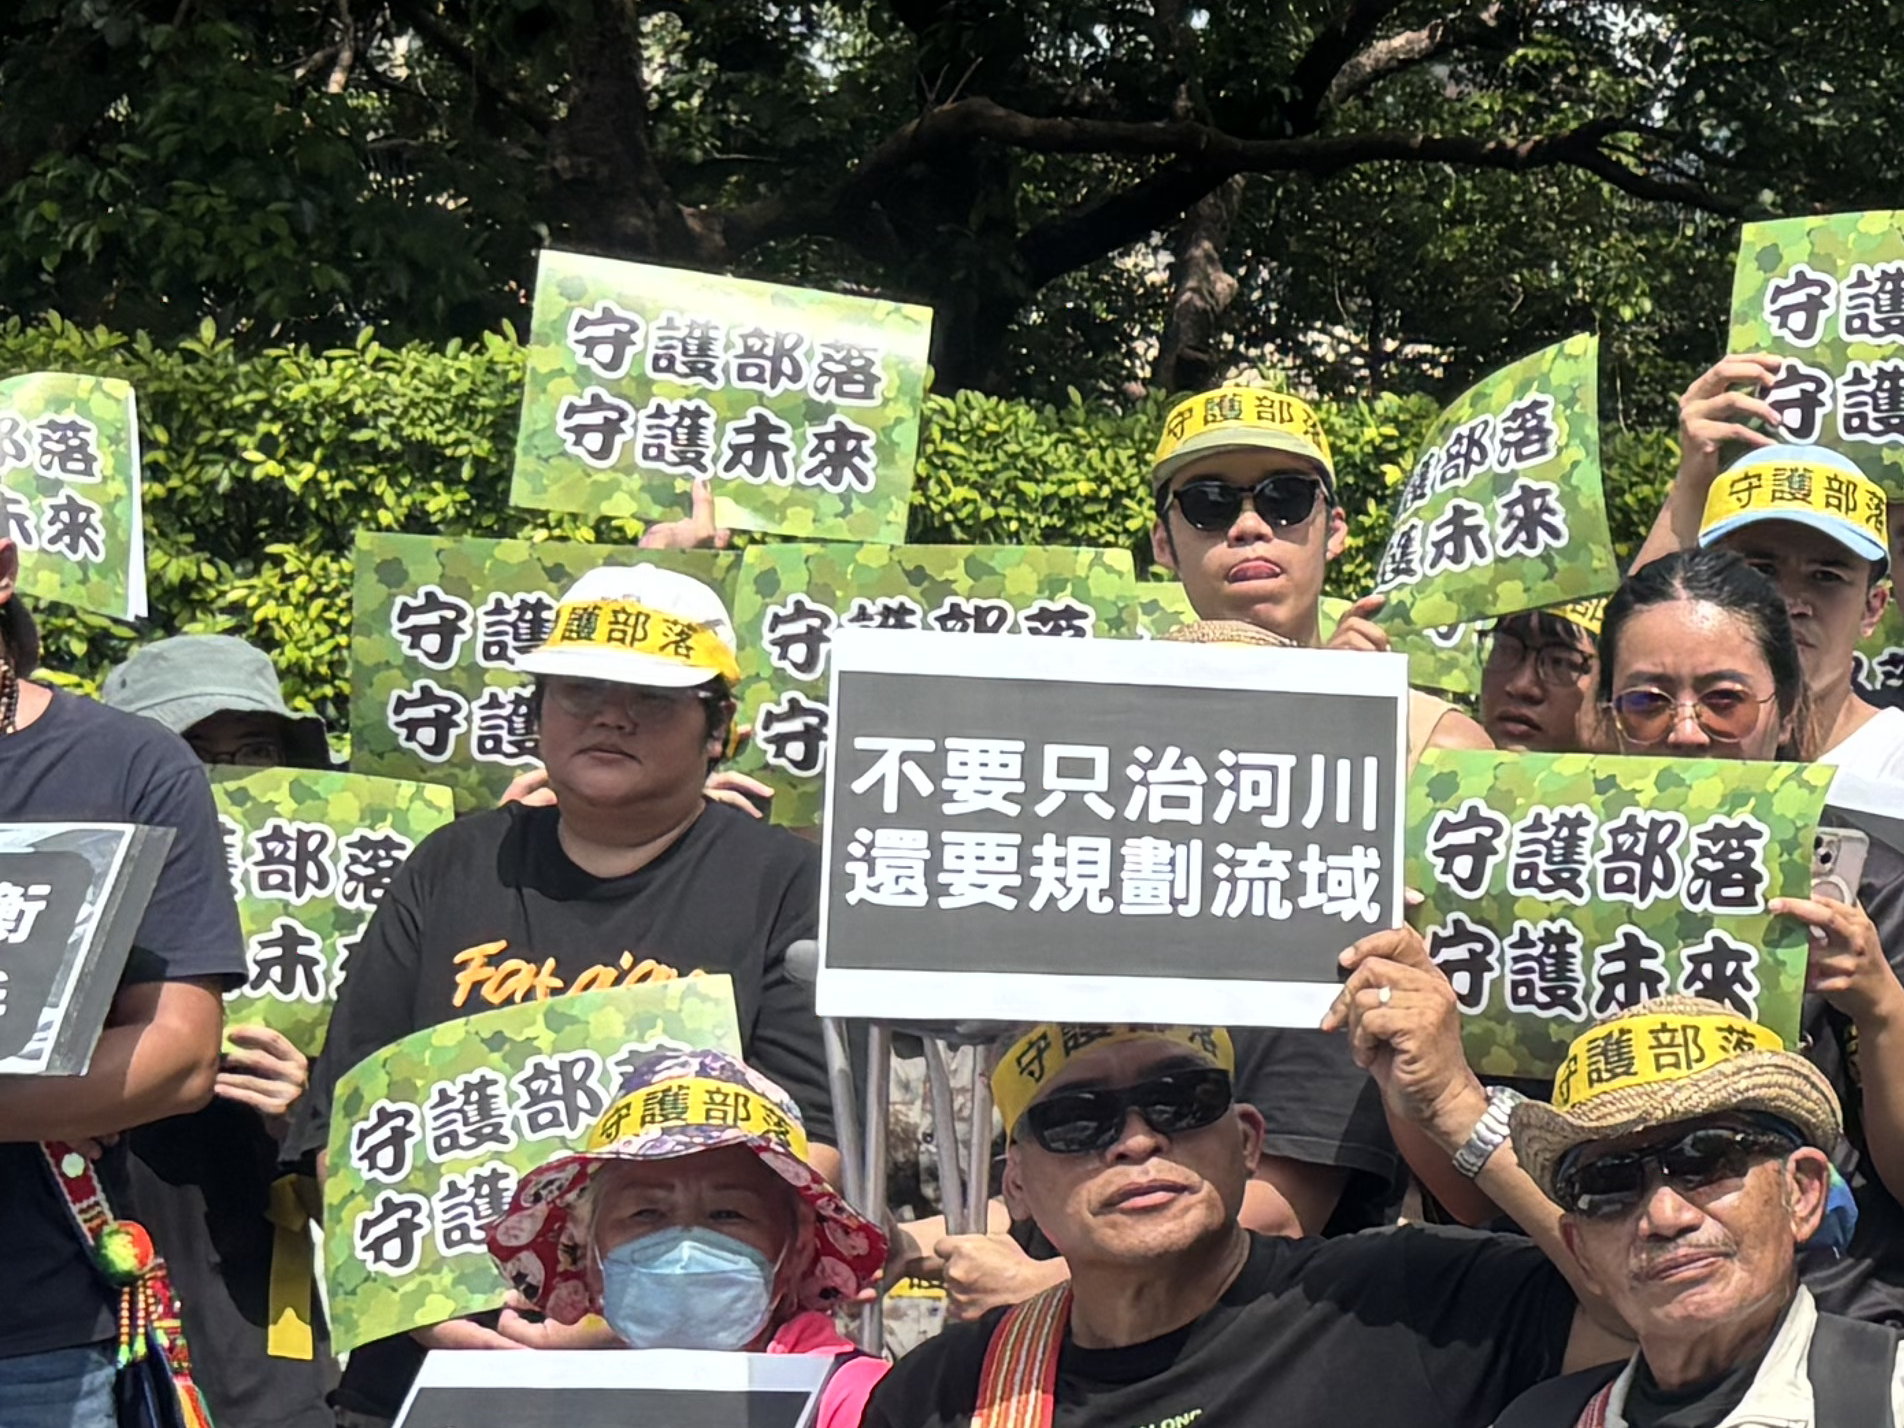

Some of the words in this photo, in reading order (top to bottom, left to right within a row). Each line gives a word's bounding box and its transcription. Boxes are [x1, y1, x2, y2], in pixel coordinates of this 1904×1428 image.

[572, 308, 882, 400] 守護部落
[565, 394, 875, 489] 守護未來
[850, 736, 1378, 832] 不要只治河川
[217, 823, 410, 902] 部落
[845, 828, 1381, 922] 還要規劃流域
[1431, 804, 1765, 908] 守護部落
